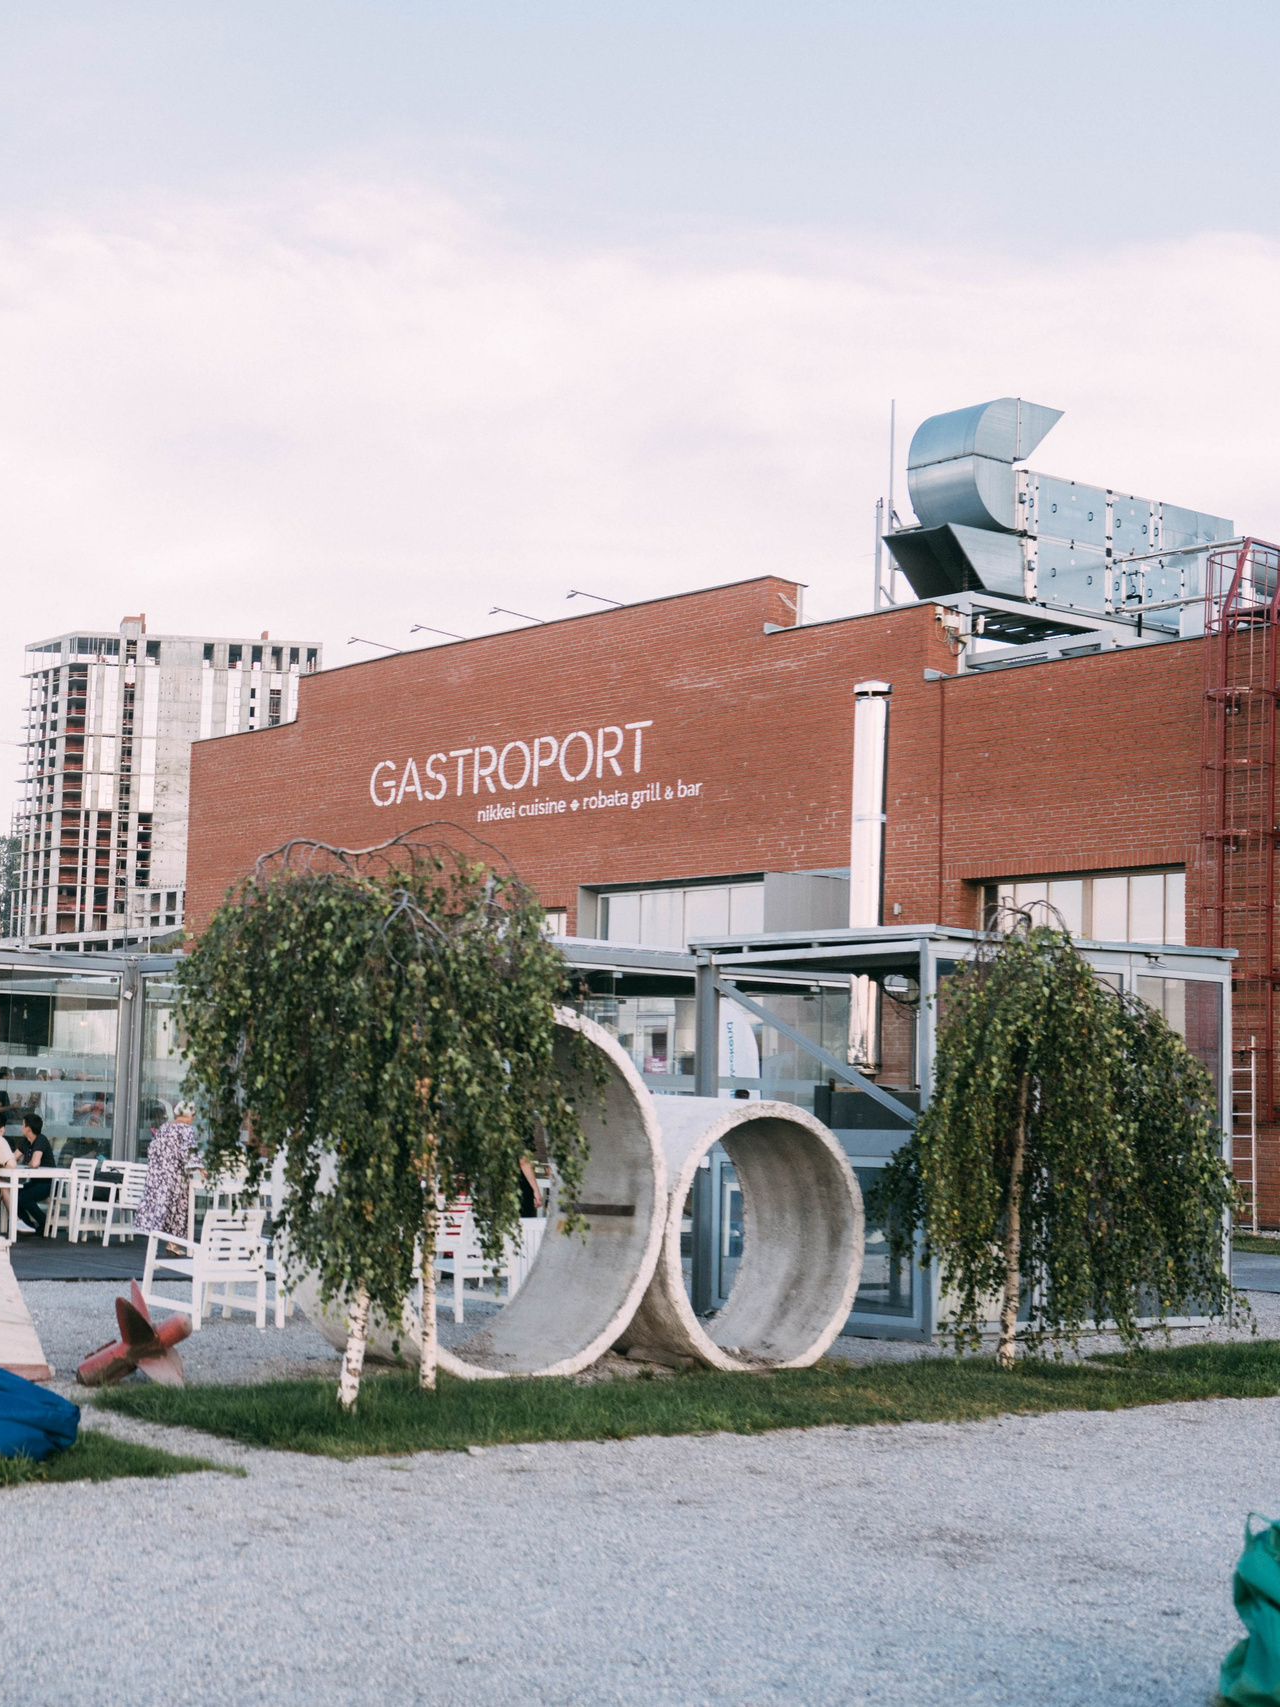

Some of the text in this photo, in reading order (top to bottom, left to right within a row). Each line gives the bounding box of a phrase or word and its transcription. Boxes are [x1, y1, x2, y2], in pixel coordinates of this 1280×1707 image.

[369, 720, 653, 807] GASTROPORT
[477, 780, 703, 823] nikkei cuisine robata grill & bar
